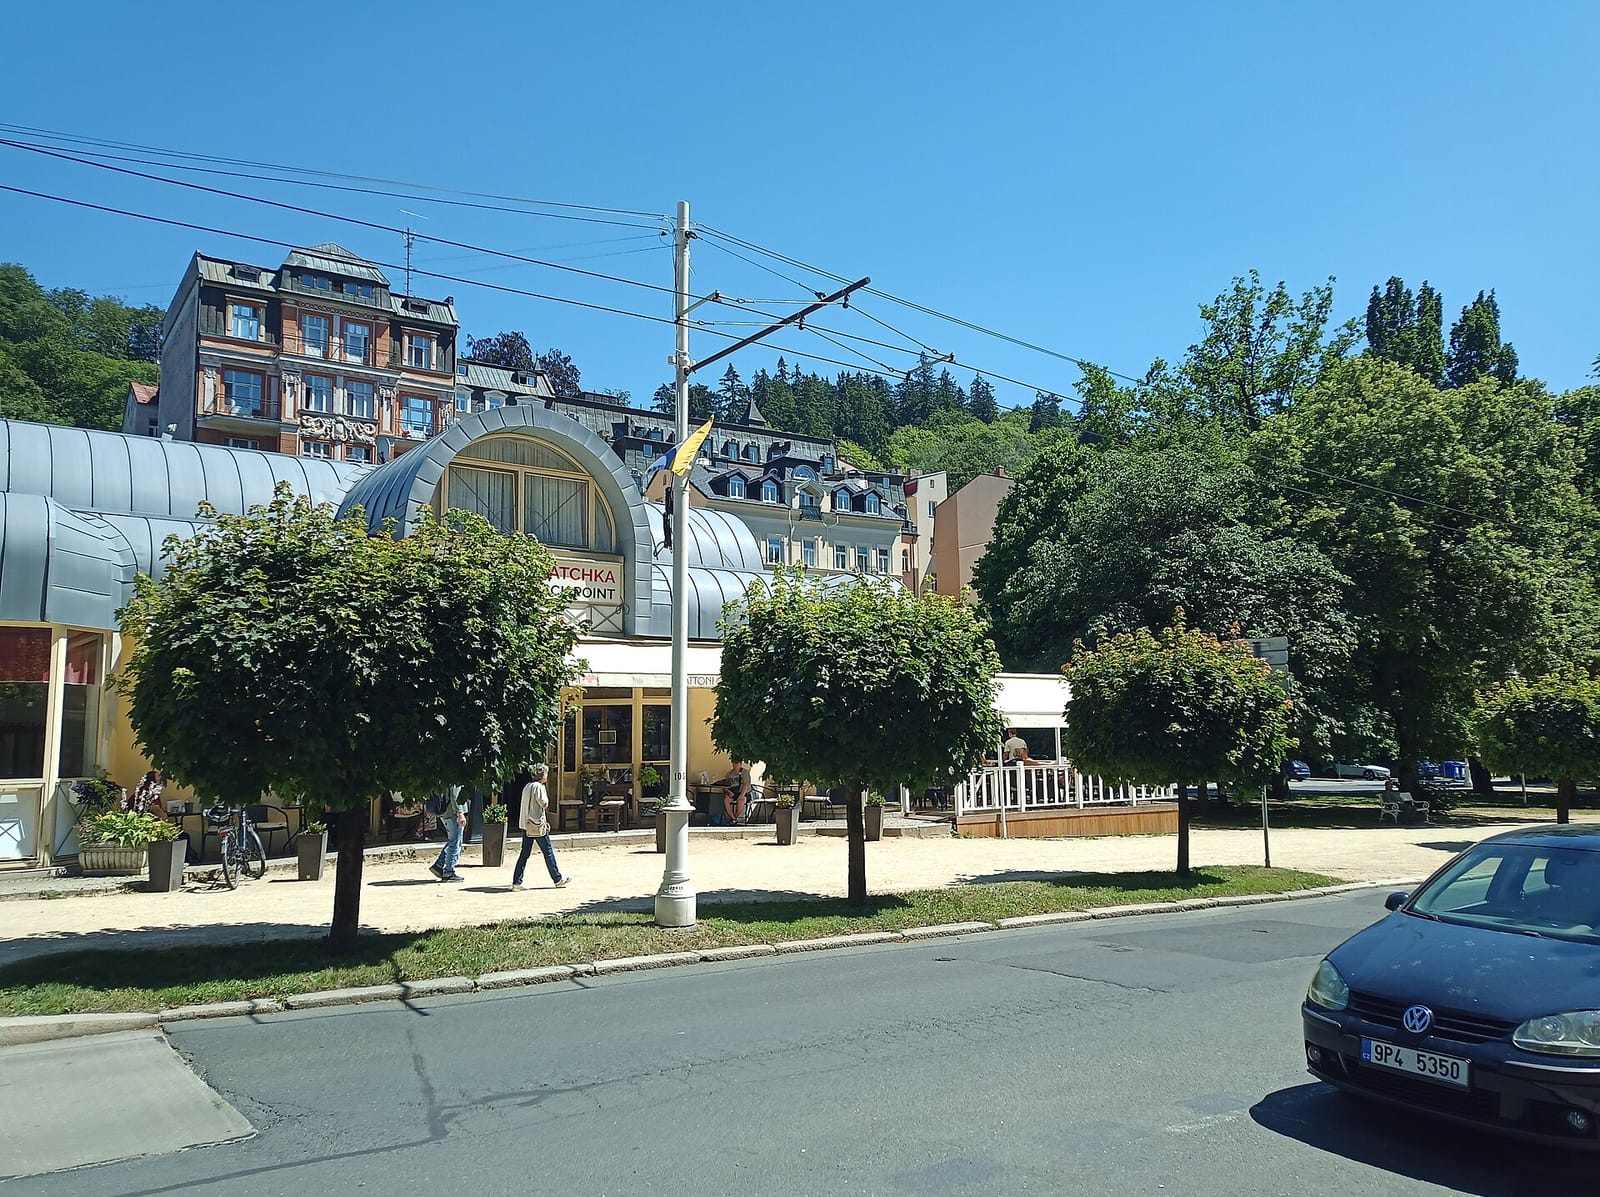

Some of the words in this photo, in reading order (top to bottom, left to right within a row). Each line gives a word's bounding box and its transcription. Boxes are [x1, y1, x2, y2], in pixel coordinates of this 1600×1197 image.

[549, 566, 616, 583] ATCHKA
[574, 586, 616, 600] POINT
[1374, 1044, 1404, 1067] 9P4
[1416, 1053, 1460, 1080] 5350
